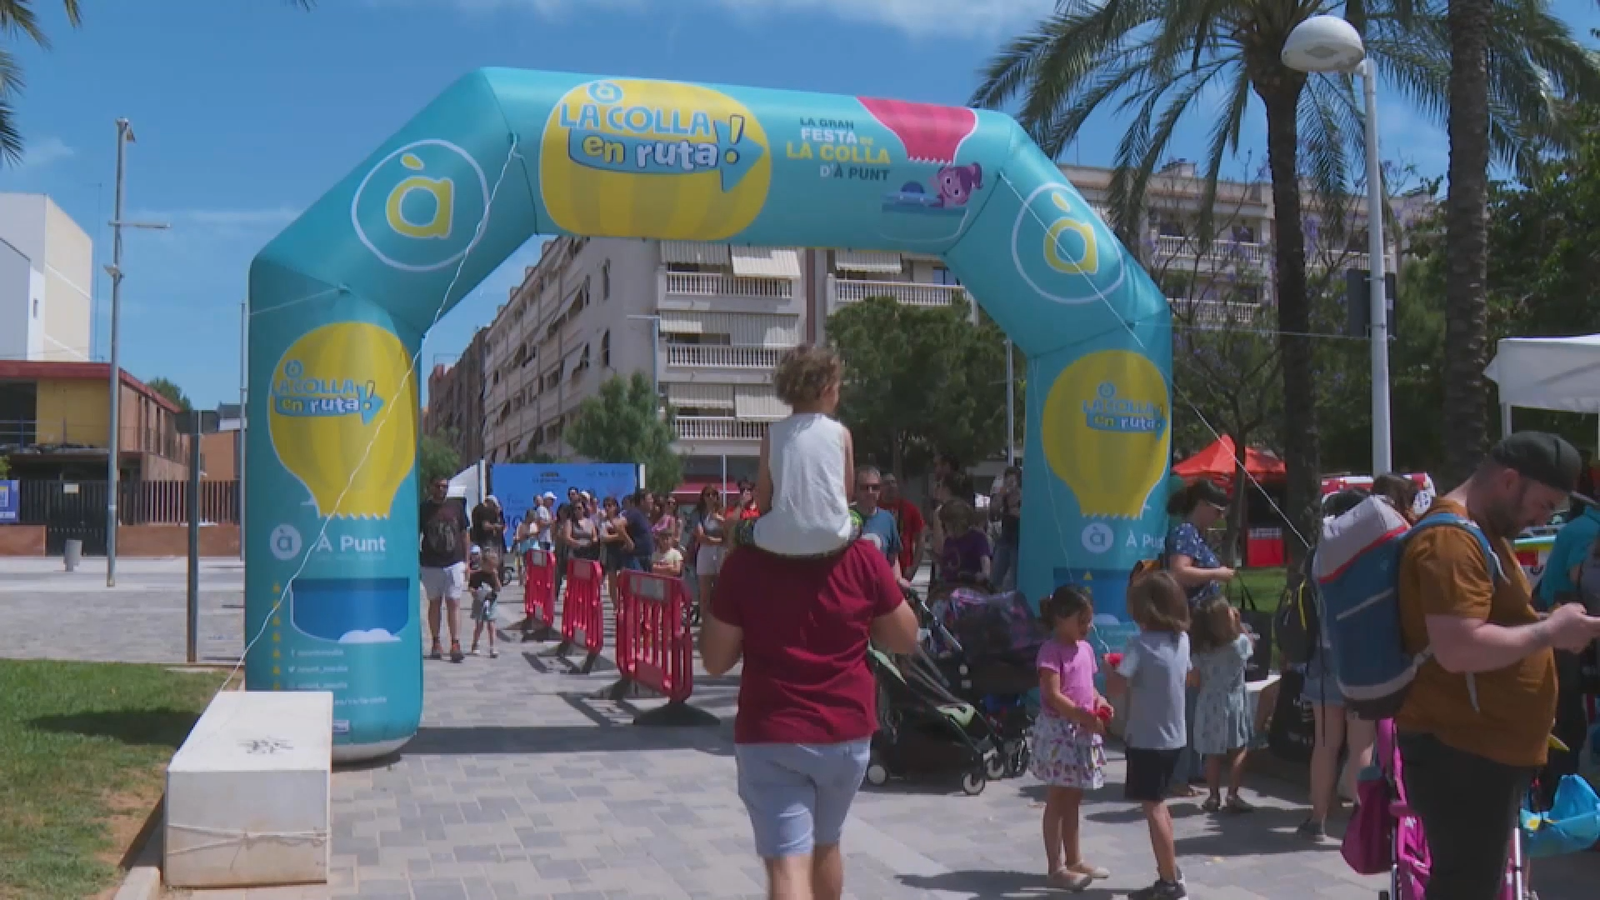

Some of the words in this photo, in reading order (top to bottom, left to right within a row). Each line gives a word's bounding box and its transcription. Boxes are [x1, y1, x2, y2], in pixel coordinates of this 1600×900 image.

[559, 102, 600, 130] LA
[606, 105, 711, 136] COLLA
[801, 128, 857, 144] FESTA
[582, 135, 625, 163] en
[786, 141, 813, 159] LA
[820, 144, 890, 164] COLLA
[848, 167, 890, 181] PUNT
[293, 377, 355, 395] COLLA
[282, 399, 303, 412] en
[341, 535, 385, 551] Punt
